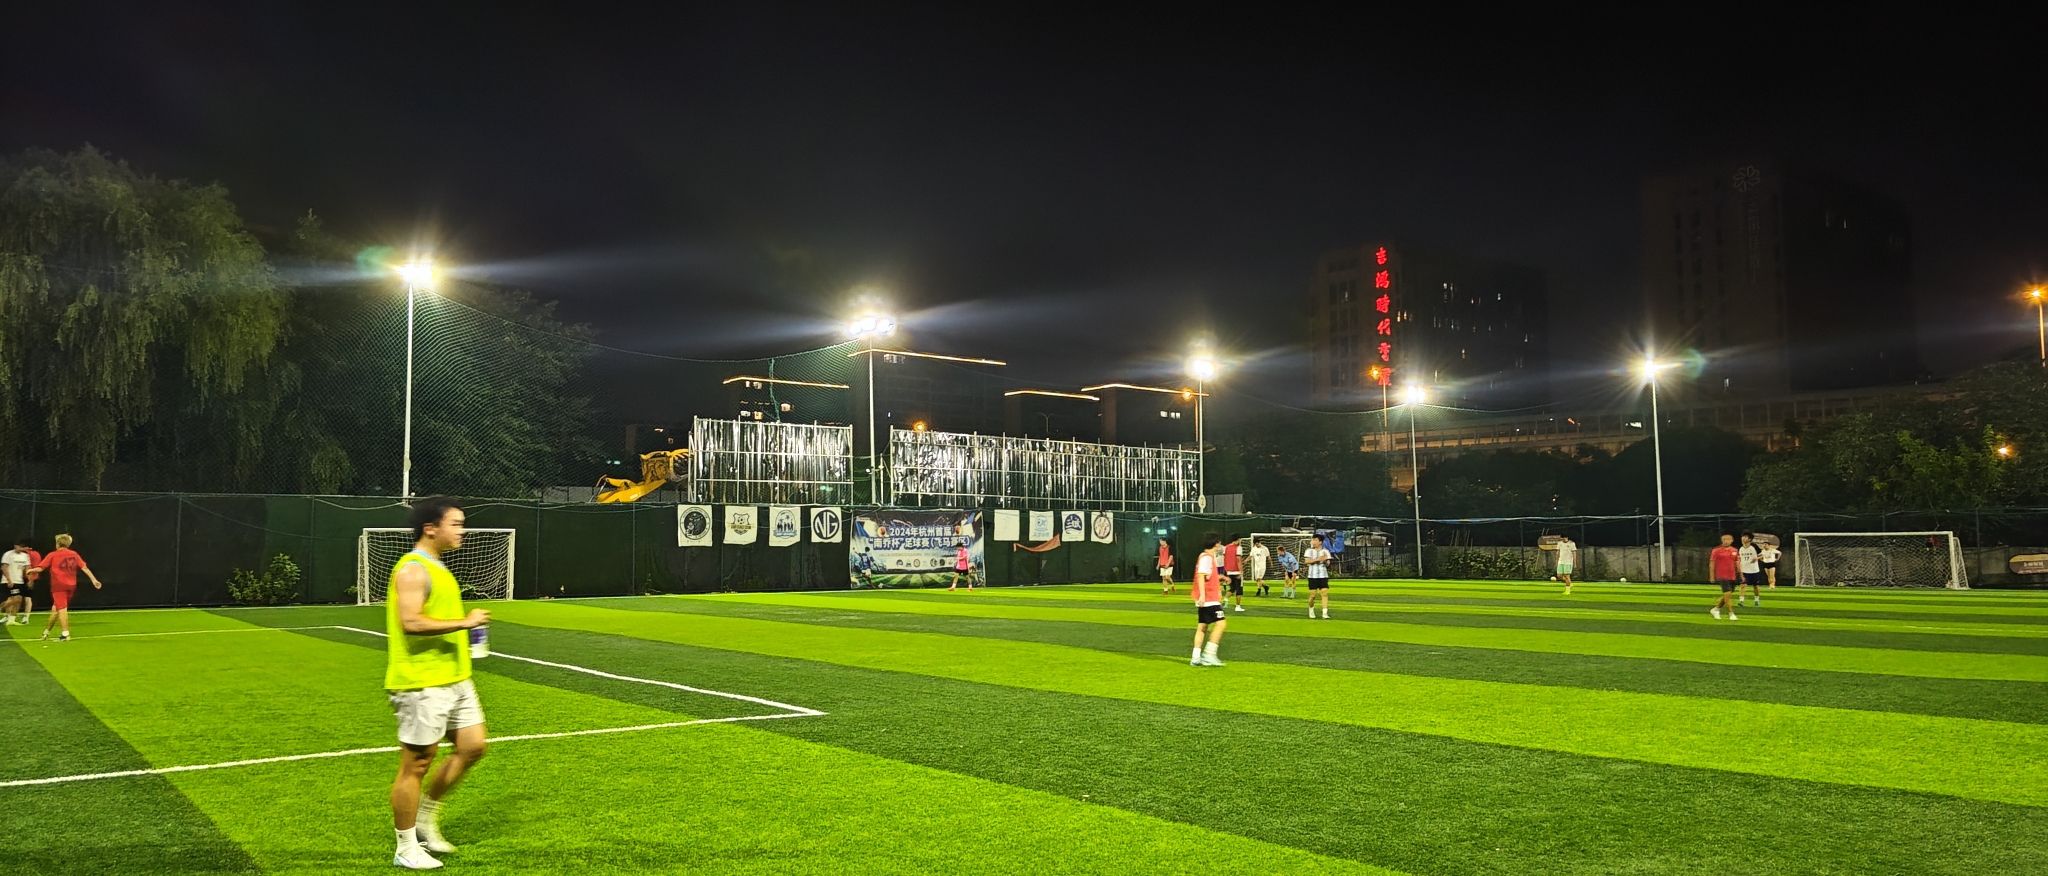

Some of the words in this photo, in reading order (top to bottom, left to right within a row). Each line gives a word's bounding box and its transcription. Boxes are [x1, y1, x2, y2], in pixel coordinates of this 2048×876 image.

[814, 510, 838, 539] NG
[890, 526, 952, 537] 2024年杭州首届
